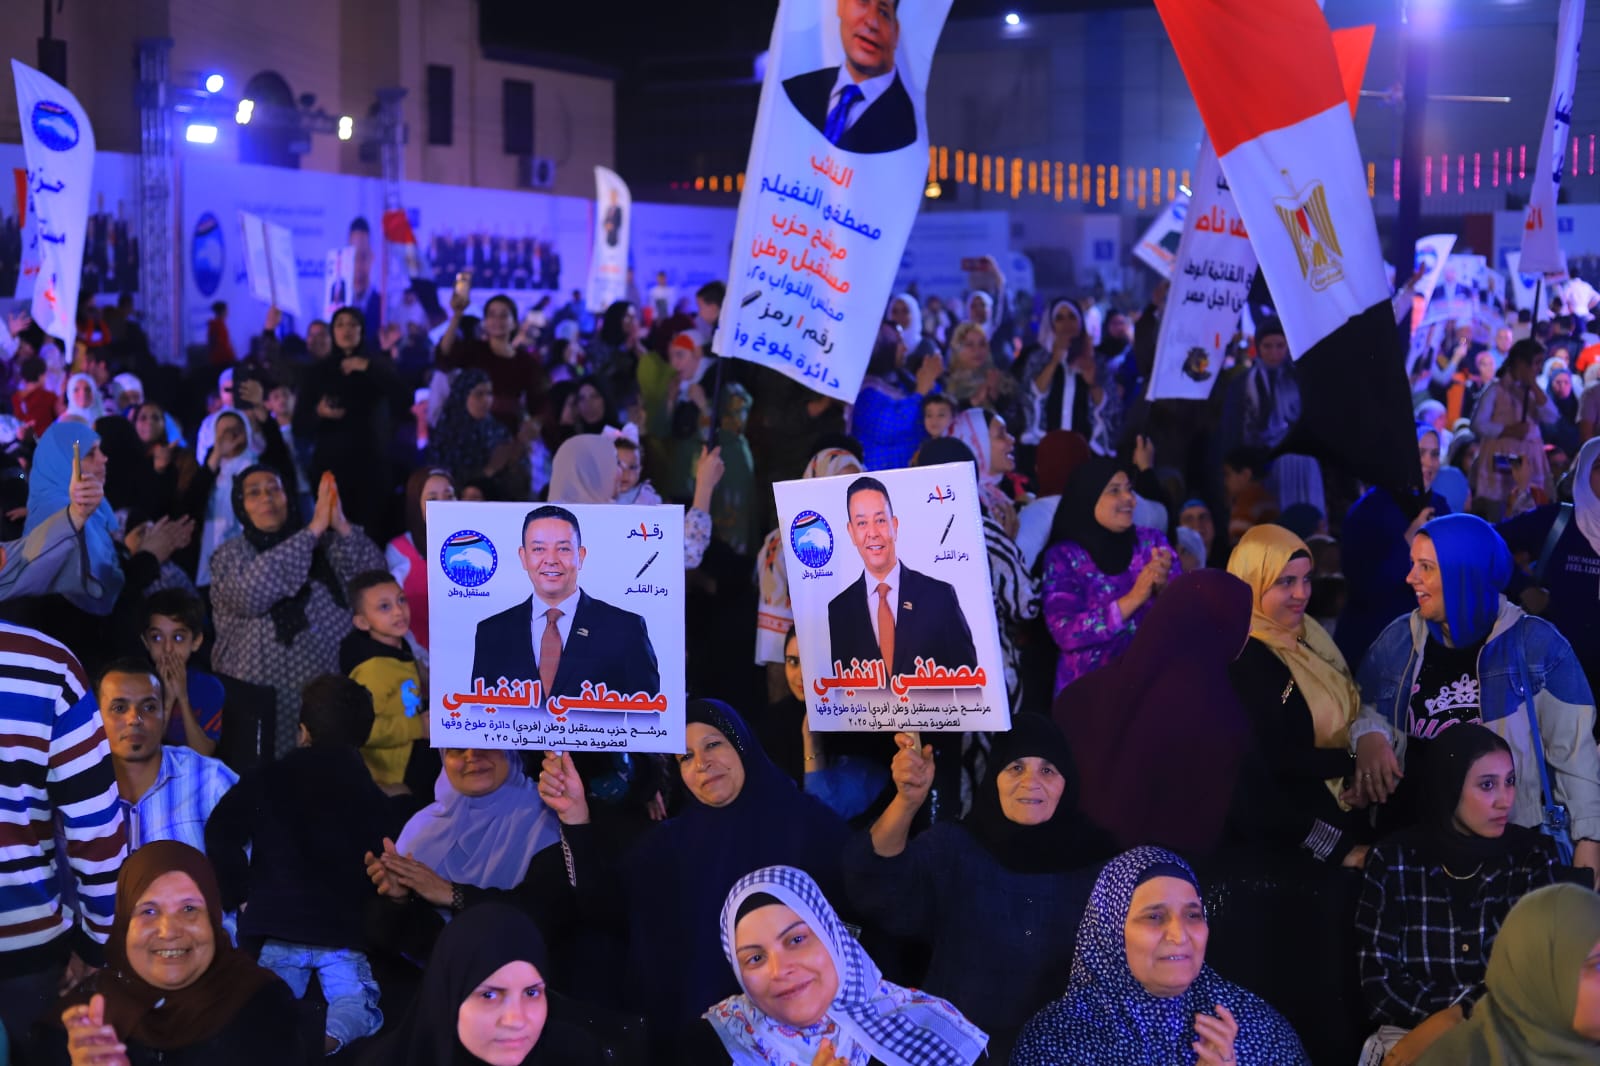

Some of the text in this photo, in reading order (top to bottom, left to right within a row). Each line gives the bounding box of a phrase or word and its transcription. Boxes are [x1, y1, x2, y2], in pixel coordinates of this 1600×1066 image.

[811, 155, 854, 188] النائب
[771, 213, 847, 261] مرشح حزب
[752, 233, 789, 265] وطن
[792, 247, 850, 294] مستقبل
[769, 274, 813, 300] النواب
[758, 302, 793, 327] رمز
[752, 332, 793, 361] طوخ
[802, 328, 834, 354] رقم
[795, 353, 839, 389] دائرة
[926, 484, 956, 503] رقم
[627, 523, 664, 540] رقم
[933, 550, 969, 563] رمز القلم
[802, 569, 834, 580] مستقبل وطن
[447, 587, 490, 598] مستقبل وطن
[624, 583, 668, 596] رمز القلم
[812, 659, 885, 704] النفيلي
[442, 677, 541, 718] النفيلي
[815, 702, 832, 715] وقها
[833, 703, 849, 716] طوخ
[850, 703, 867, 716] دائرة
[892, 702, 909, 716] وطن
[911, 703, 940, 715] مستقبل
[941, 704, 959, 716] حزب
[961, 703, 992, 716] مرشح
[441, 717, 668, 738] مرشح حزب مستقبل وطن (فردي) دائرة طوخ وقها
[848, 717, 961, 730] لعضوية مجلس النواب ٢٠٢٥
[483, 732, 628, 749] لعضوية مجلس النواب ٢٠٢٥
